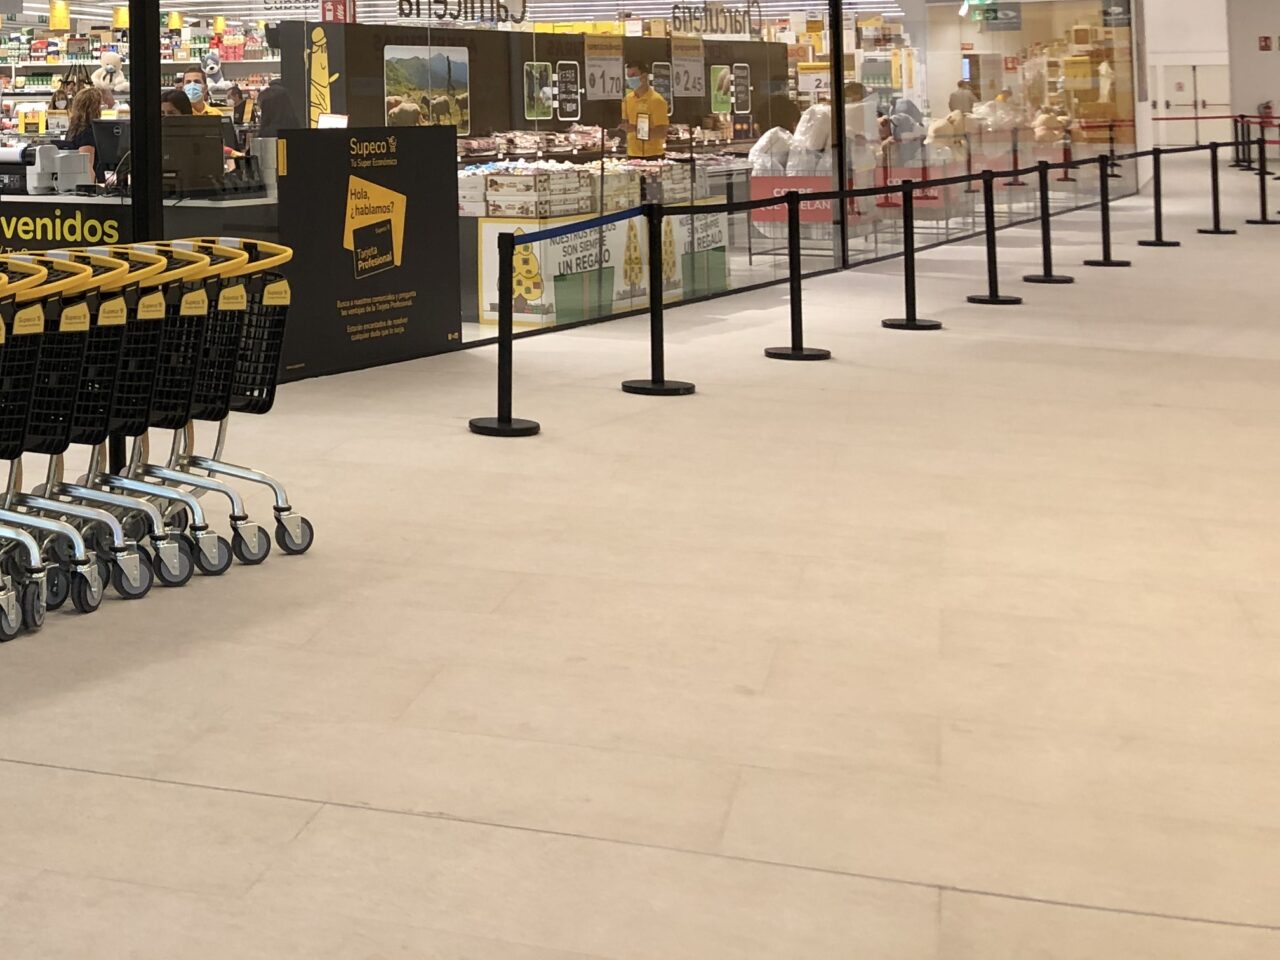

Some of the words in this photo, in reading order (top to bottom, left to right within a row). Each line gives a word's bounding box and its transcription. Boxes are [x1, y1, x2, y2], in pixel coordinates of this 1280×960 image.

[349, 137, 387, 157] Supeco
[349, 188, 370, 201] Hola,
[350, 201, 395, 219] ¿hablamos?
[562, 243, 579, 257] SON
[558, 260, 573, 274] UN
